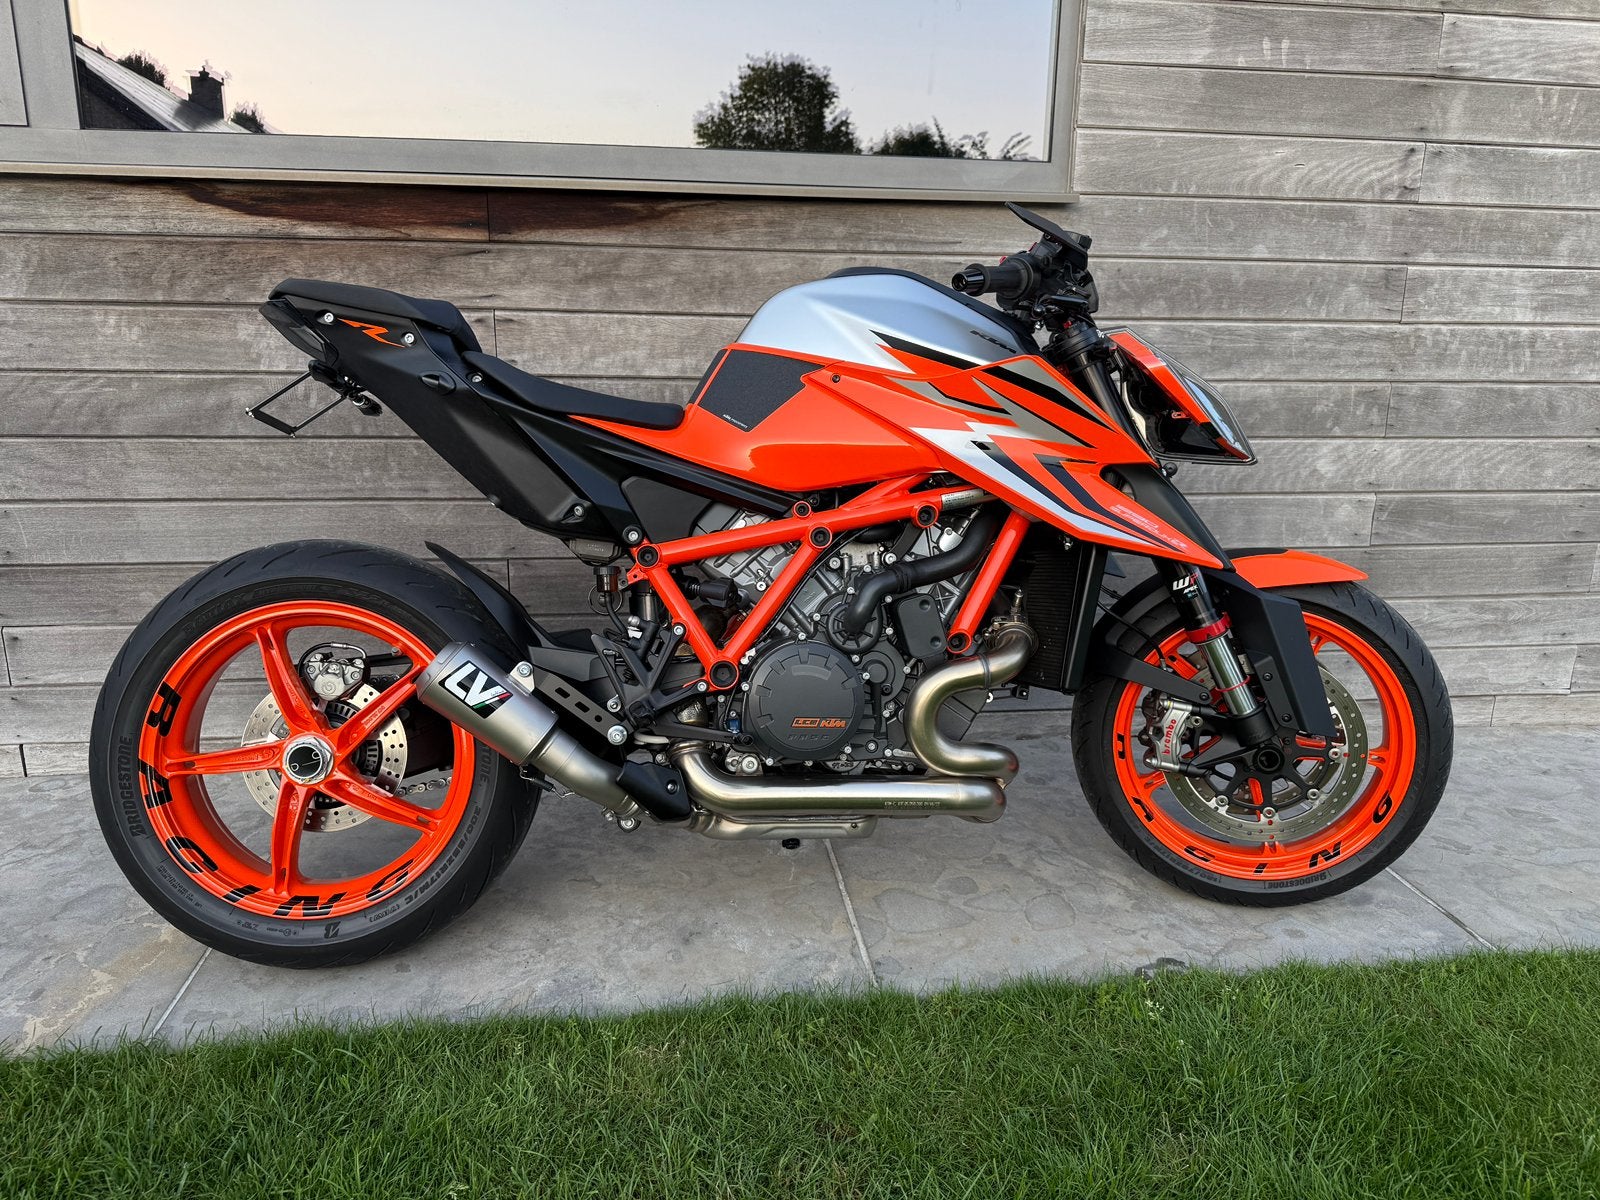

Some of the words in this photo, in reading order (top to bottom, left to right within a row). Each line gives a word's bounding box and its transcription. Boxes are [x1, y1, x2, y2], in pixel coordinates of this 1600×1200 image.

[820, 717, 847, 728] KTM
[1161, 719, 1177, 756] brembo
[118, 735, 147, 837] BRIDGESTONE
[138, 681, 414, 917] RACING
[1267, 871, 1328, 890] BRIDGESTONE
